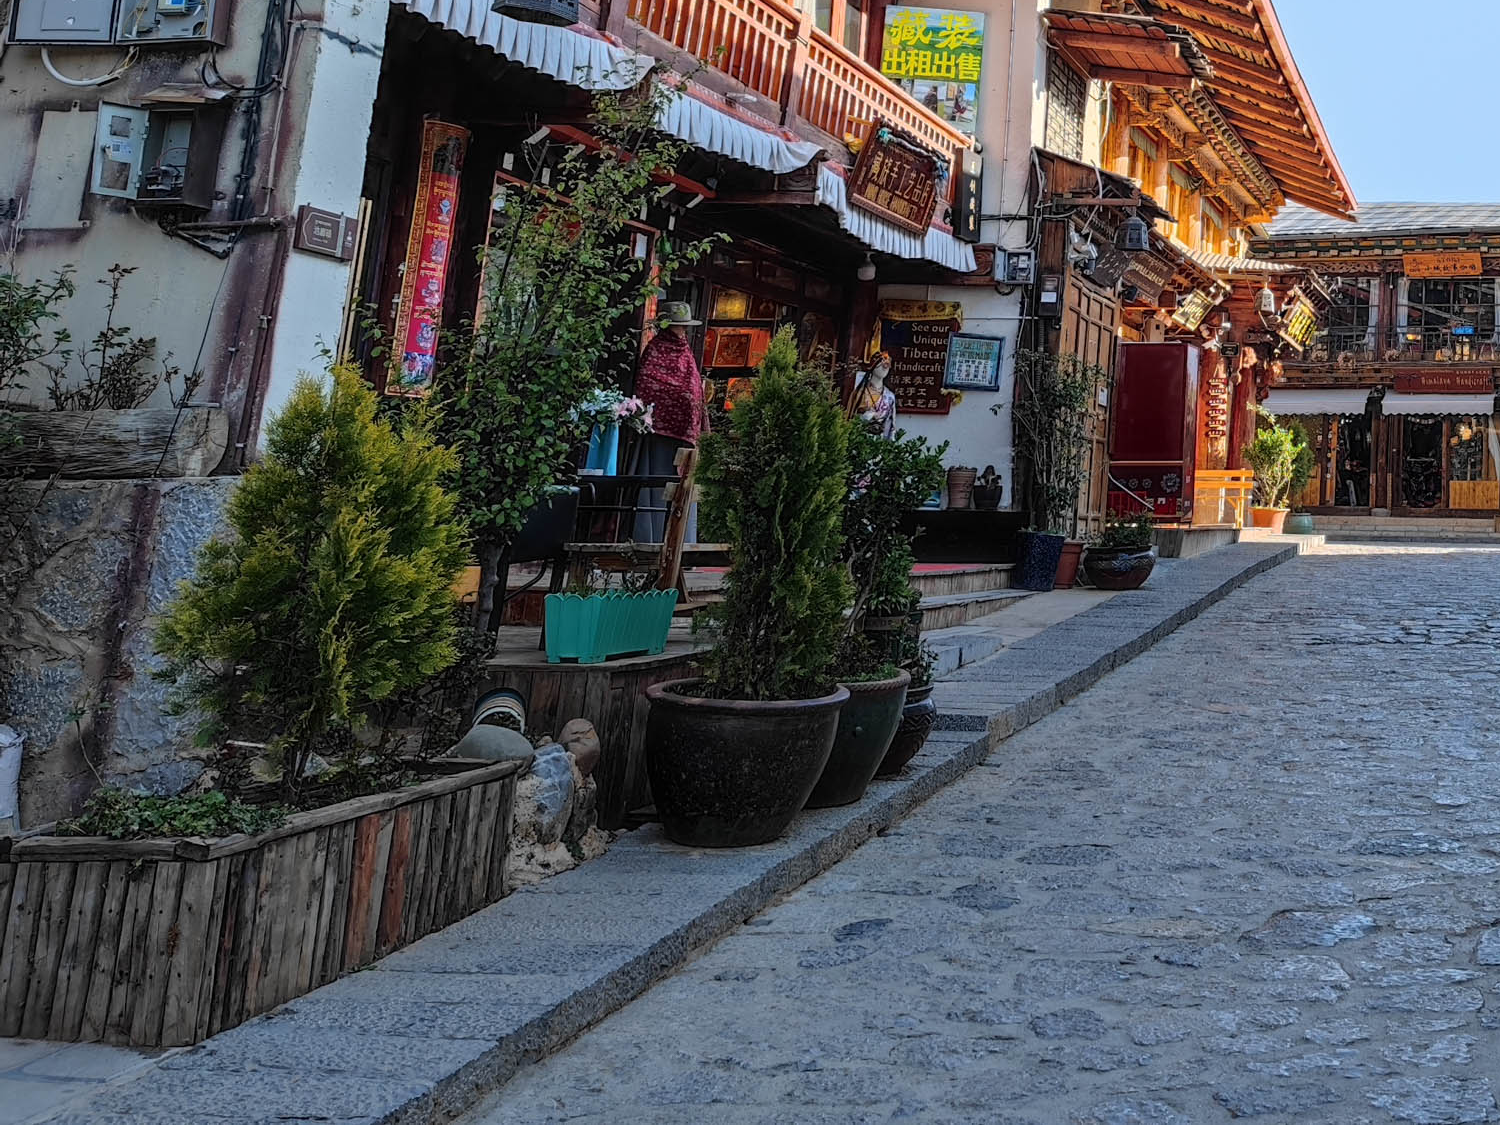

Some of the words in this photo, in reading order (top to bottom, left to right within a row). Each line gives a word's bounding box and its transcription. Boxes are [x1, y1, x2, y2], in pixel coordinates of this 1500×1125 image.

[890, 9, 979, 50] 藏装
[882, 48, 981, 81] 出租出售
[911, 322, 931, 332] See
[932, 324, 950, 333] our
[913, 334, 949, 347] Unique
[902, 347, 947, 360] Tibetan
